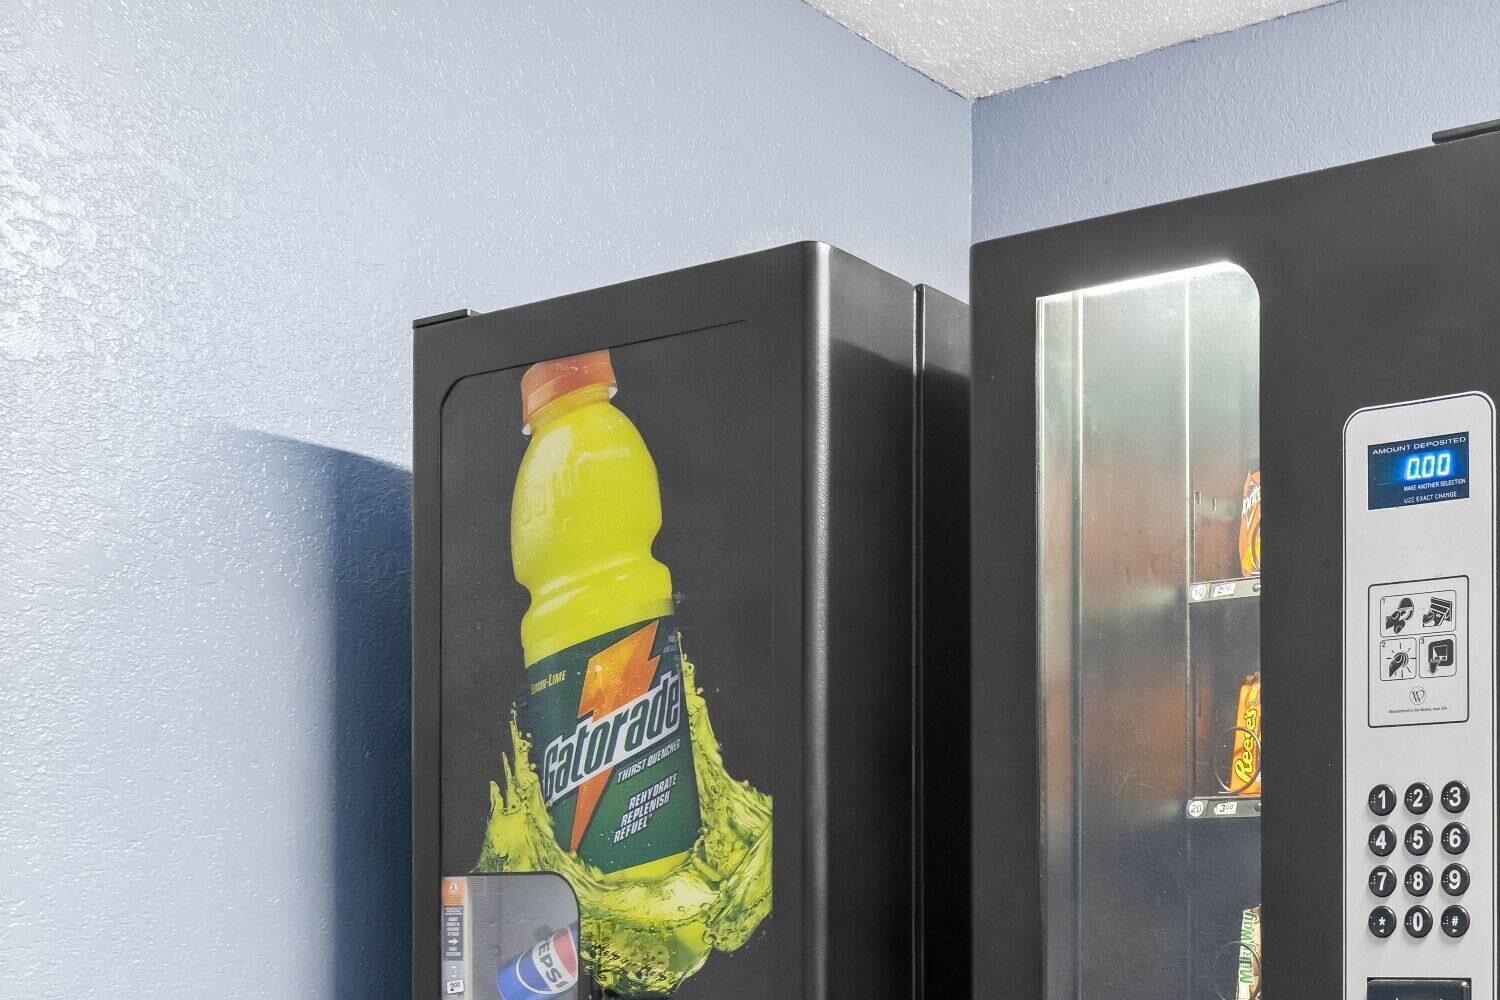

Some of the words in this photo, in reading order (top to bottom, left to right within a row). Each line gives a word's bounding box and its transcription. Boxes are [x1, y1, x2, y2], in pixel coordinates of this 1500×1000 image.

[1372, 444, 1411, 455] AMOUNT
[1413, 436, 1466, 449] DEPOSITED
[1417, 480, 1440, 490] ANOTHER
[1440, 478, 1466, 488] SELECTION
[1416, 493, 1433, 502] EXACT
[1434, 491, 1457, 500] CHANGE
[543, 670, 680, 809] Gatorade
[616, 757, 648, 786] THIRST
[628, 772, 679, 810] REHYDRATE
[1377, 789, 1387, 810] 1
[1412, 788, 1424, 808] 2
[1448, 786, 1462, 807] 3
[620, 790, 671, 828] REPLENISH
[1375, 830, 1387, 850] 4
[1411, 829, 1424, 850] 5
[1449, 827, 1461, 848] 6
[1376, 871, 1388, 891] 7
[1412, 870, 1424, 891] 8
[1448, 869, 1461, 890] 9
[1412, 911, 1424, 932] 0
[538, 938, 569, 990] EPSI
